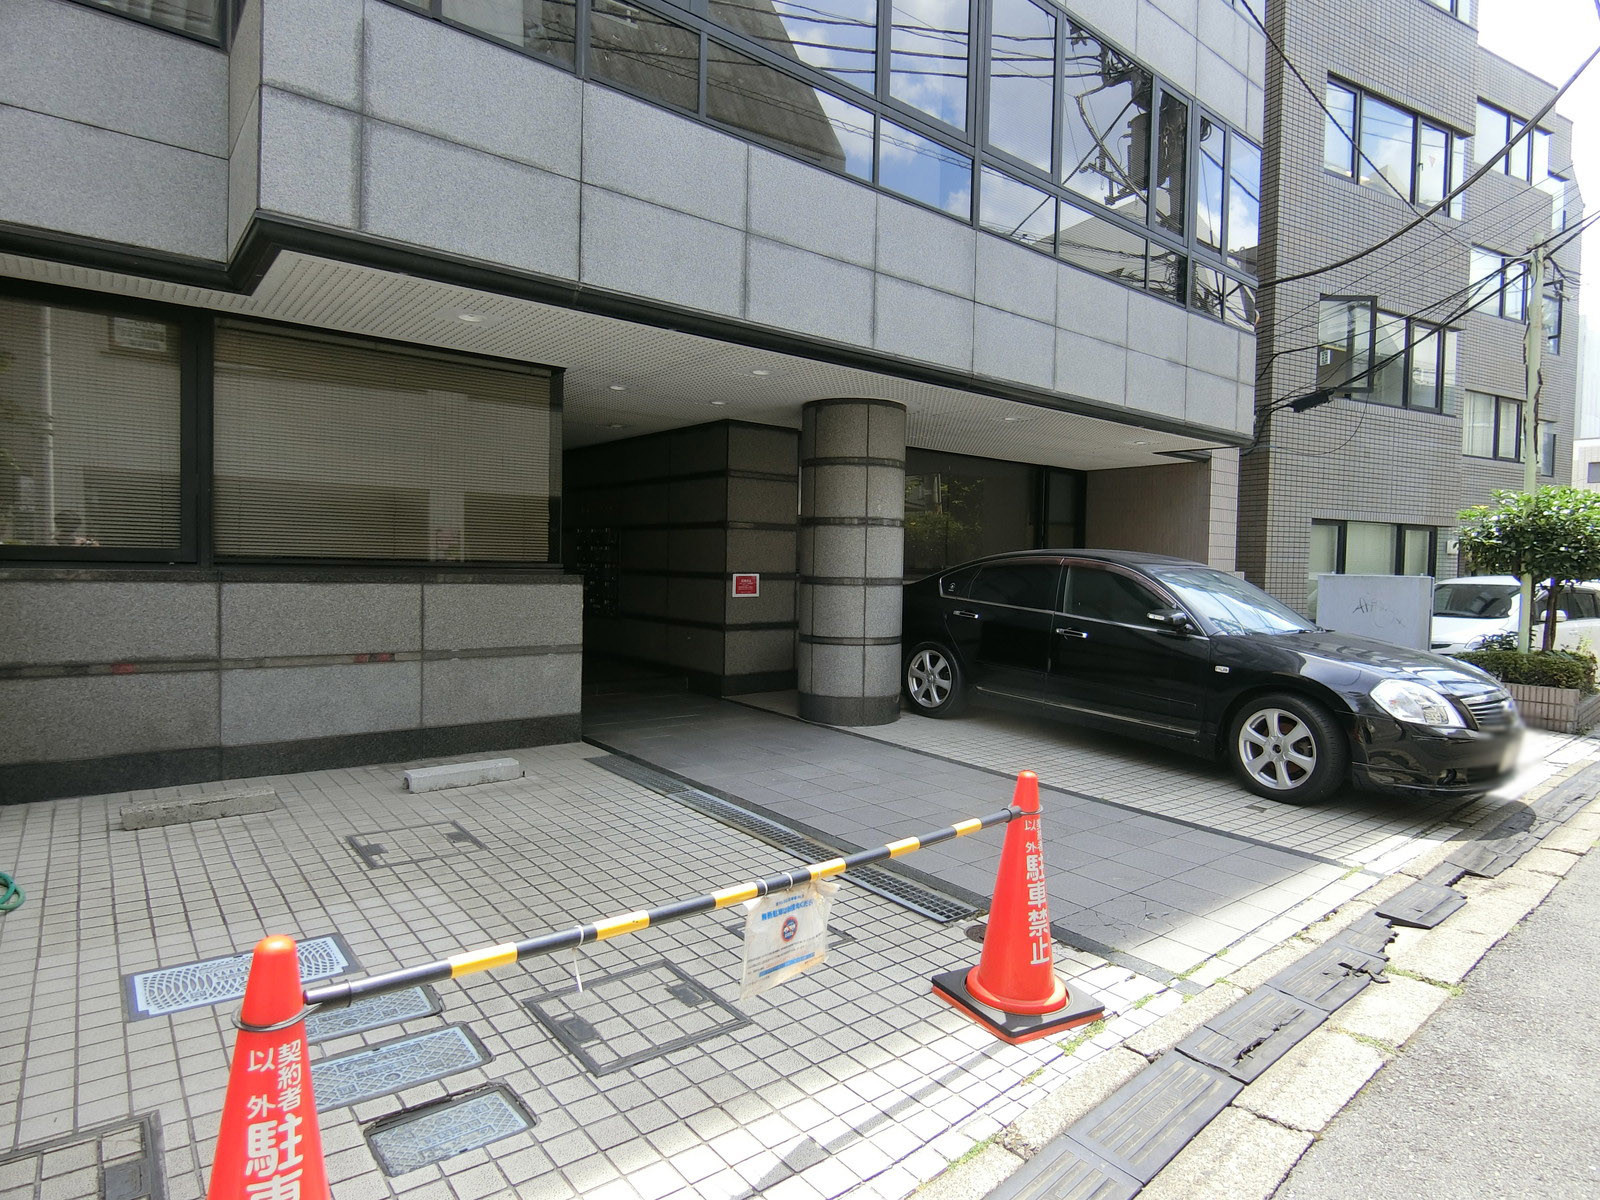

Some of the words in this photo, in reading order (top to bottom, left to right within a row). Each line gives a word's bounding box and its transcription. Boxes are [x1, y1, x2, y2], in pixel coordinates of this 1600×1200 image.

[1024, 819, 1037, 853] 以外
[1026, 853, 1050, 965] 駐車禁止
[247, 1047, 276, 1119] 以外
[277, 1038, 302, 1112] 契約者
